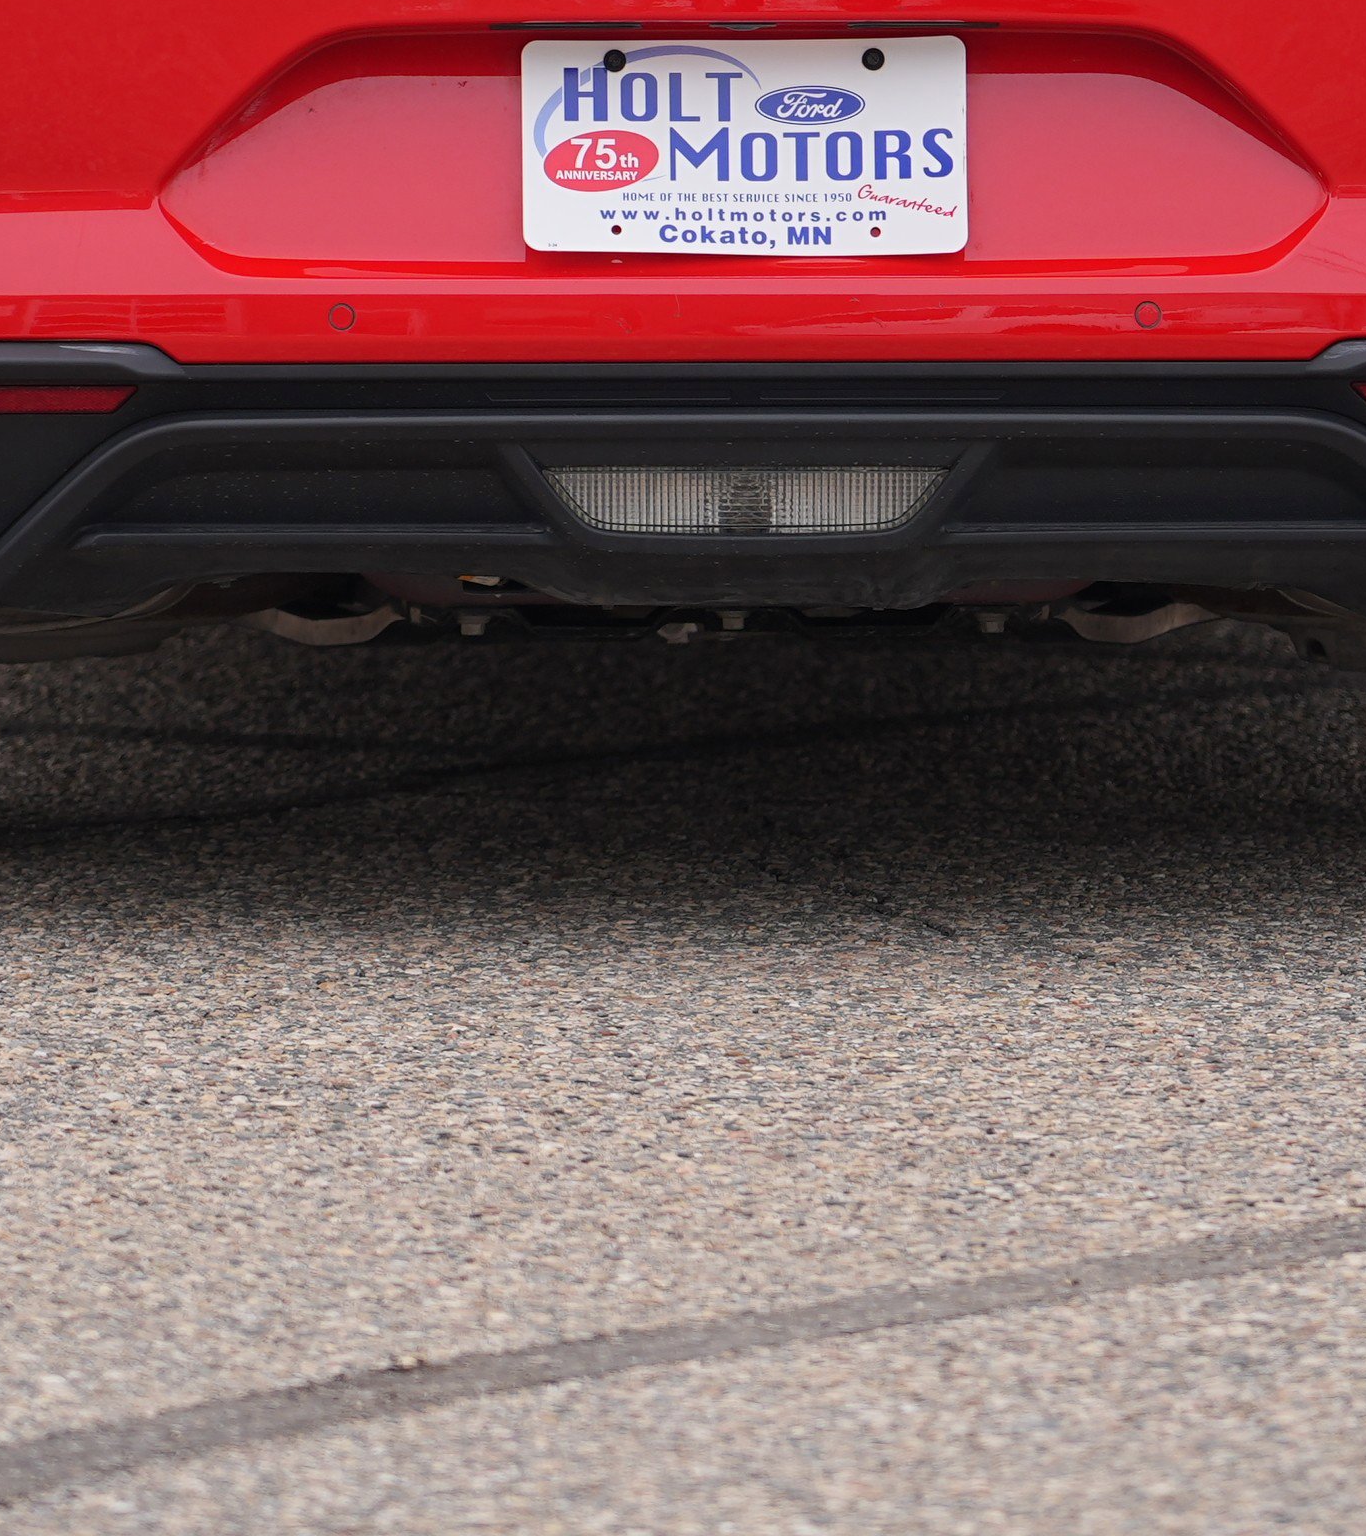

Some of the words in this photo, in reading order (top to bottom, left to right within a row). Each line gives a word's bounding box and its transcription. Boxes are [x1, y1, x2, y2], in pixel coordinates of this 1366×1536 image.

[563, 67, 743, 123] HOLT
[776, 91, 844, 119] Ford
[570, 138, 639, 170] 75th
[669, 127, 954, 182] MOTORS
[555, 169, 639, 181] ANNIVERSARY
[621, 192, 655, 202] HOME
[659, 192, 675, 202] OF
[677, 192, 699, 203] THE
[701, 193, 729, 203] BEST
[732, 193, 780, 203] SERVICE
[784, 192, 818, 203] SINCE
[824, 192, 853, 203] 1950
[857, 184, 958, 218] Guaranteed
[600, 207, 887, 223] www.holtmotors.com
[658, 223, 777, 249] Cokato,
[787, 225, 833, 246] MN
